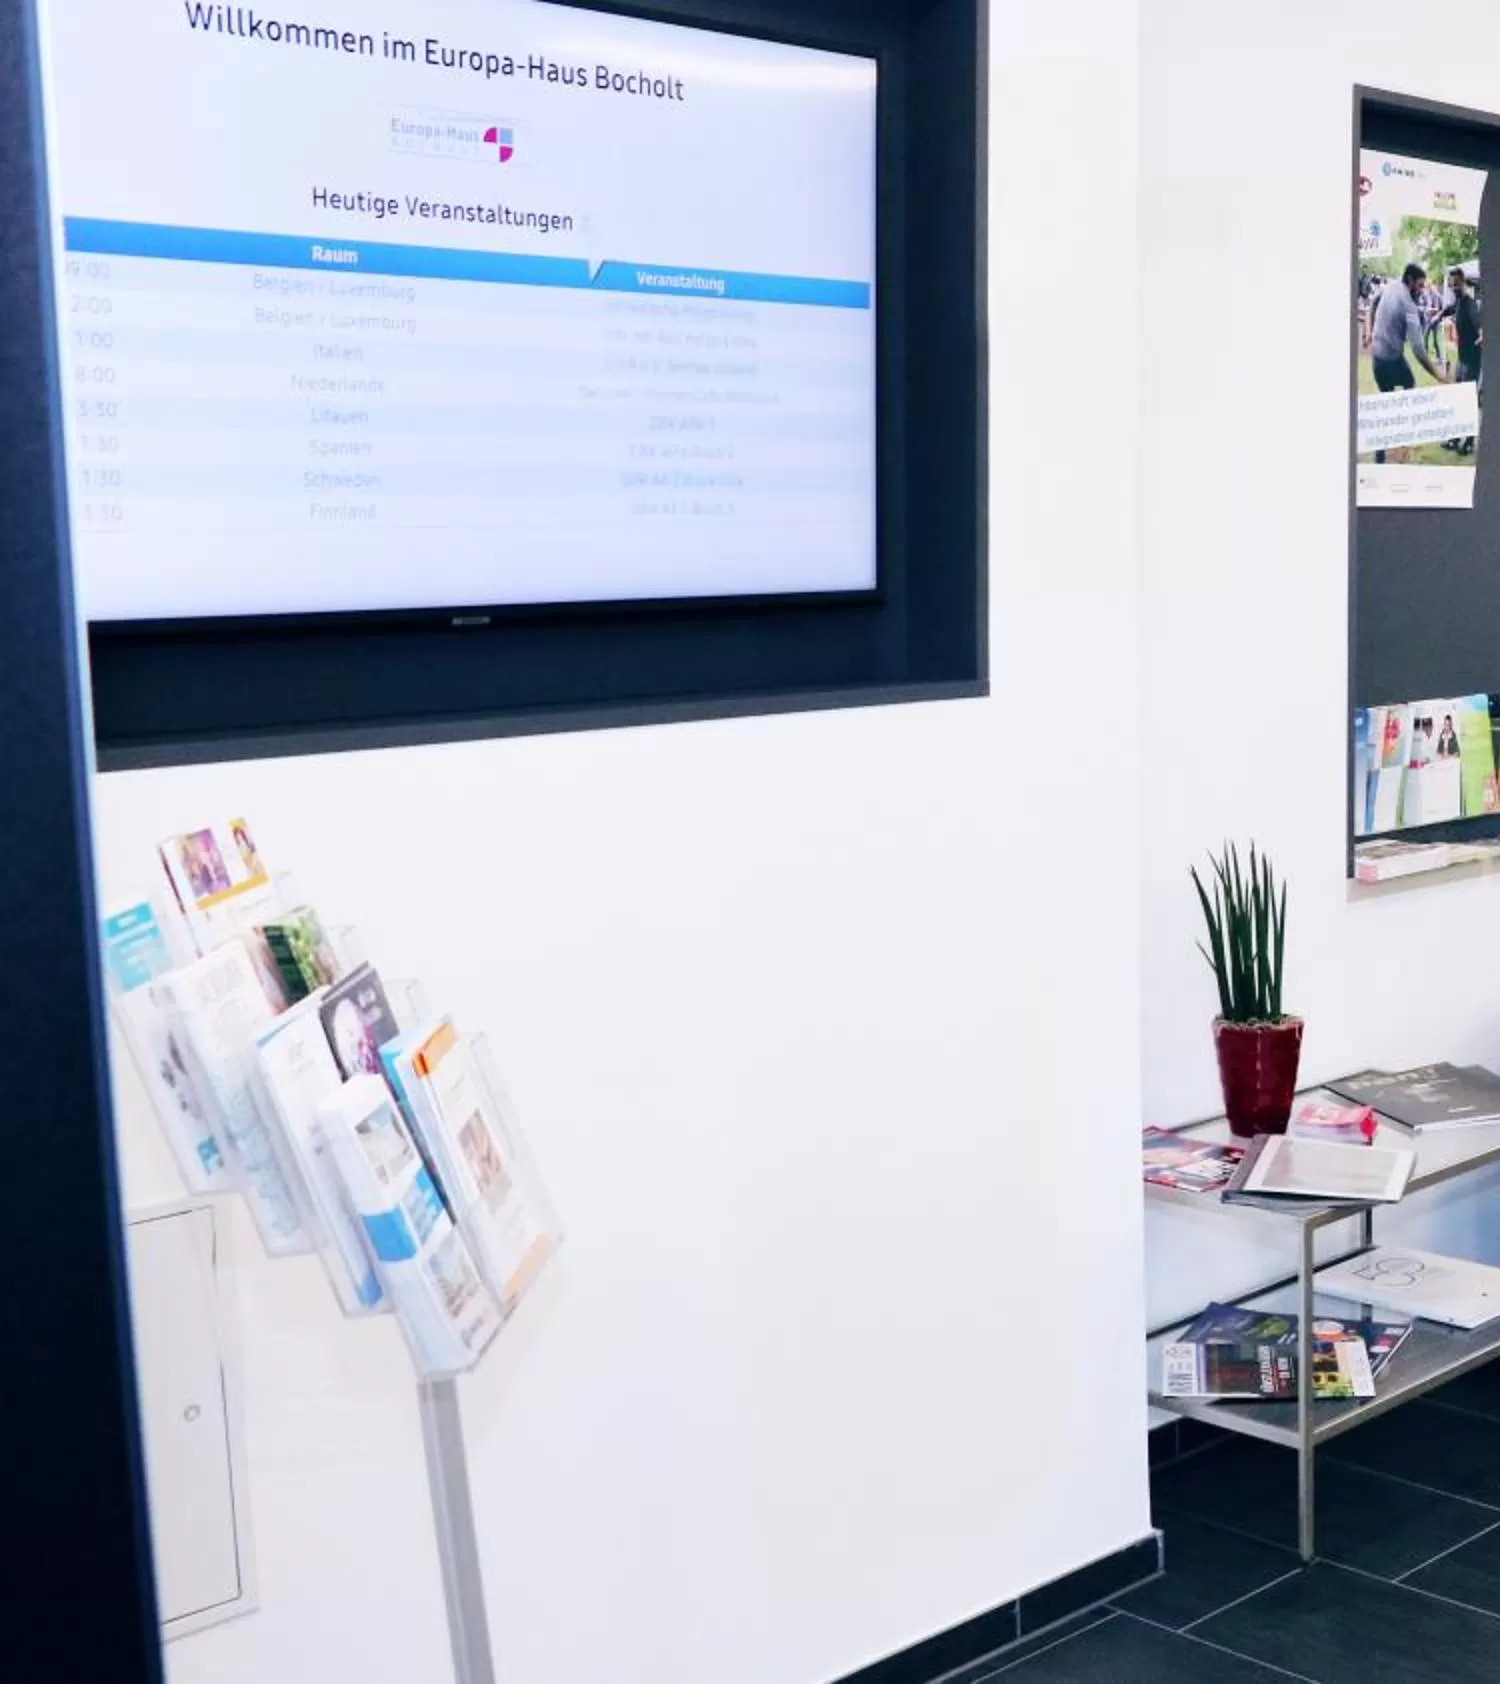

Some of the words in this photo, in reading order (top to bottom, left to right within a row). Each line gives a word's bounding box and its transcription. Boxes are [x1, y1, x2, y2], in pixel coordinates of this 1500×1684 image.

[184, 0, 374, 56] Willkommen
[383, 31, 416, 62] im
[424, 38, 588, 87] Europa-Haus
[594, 64, 685, 101] Bocholt
[312, 186, 399, 219] Heutige
[405, 195, 574, 234] Veranstaltungen
[311, 244, 358, 265] Raum
[329, 281, 416, 304] Luxemburg
[636, 271, 727, 295] Veranstaltung
[330, 314, 417, 336] Luxemburg
